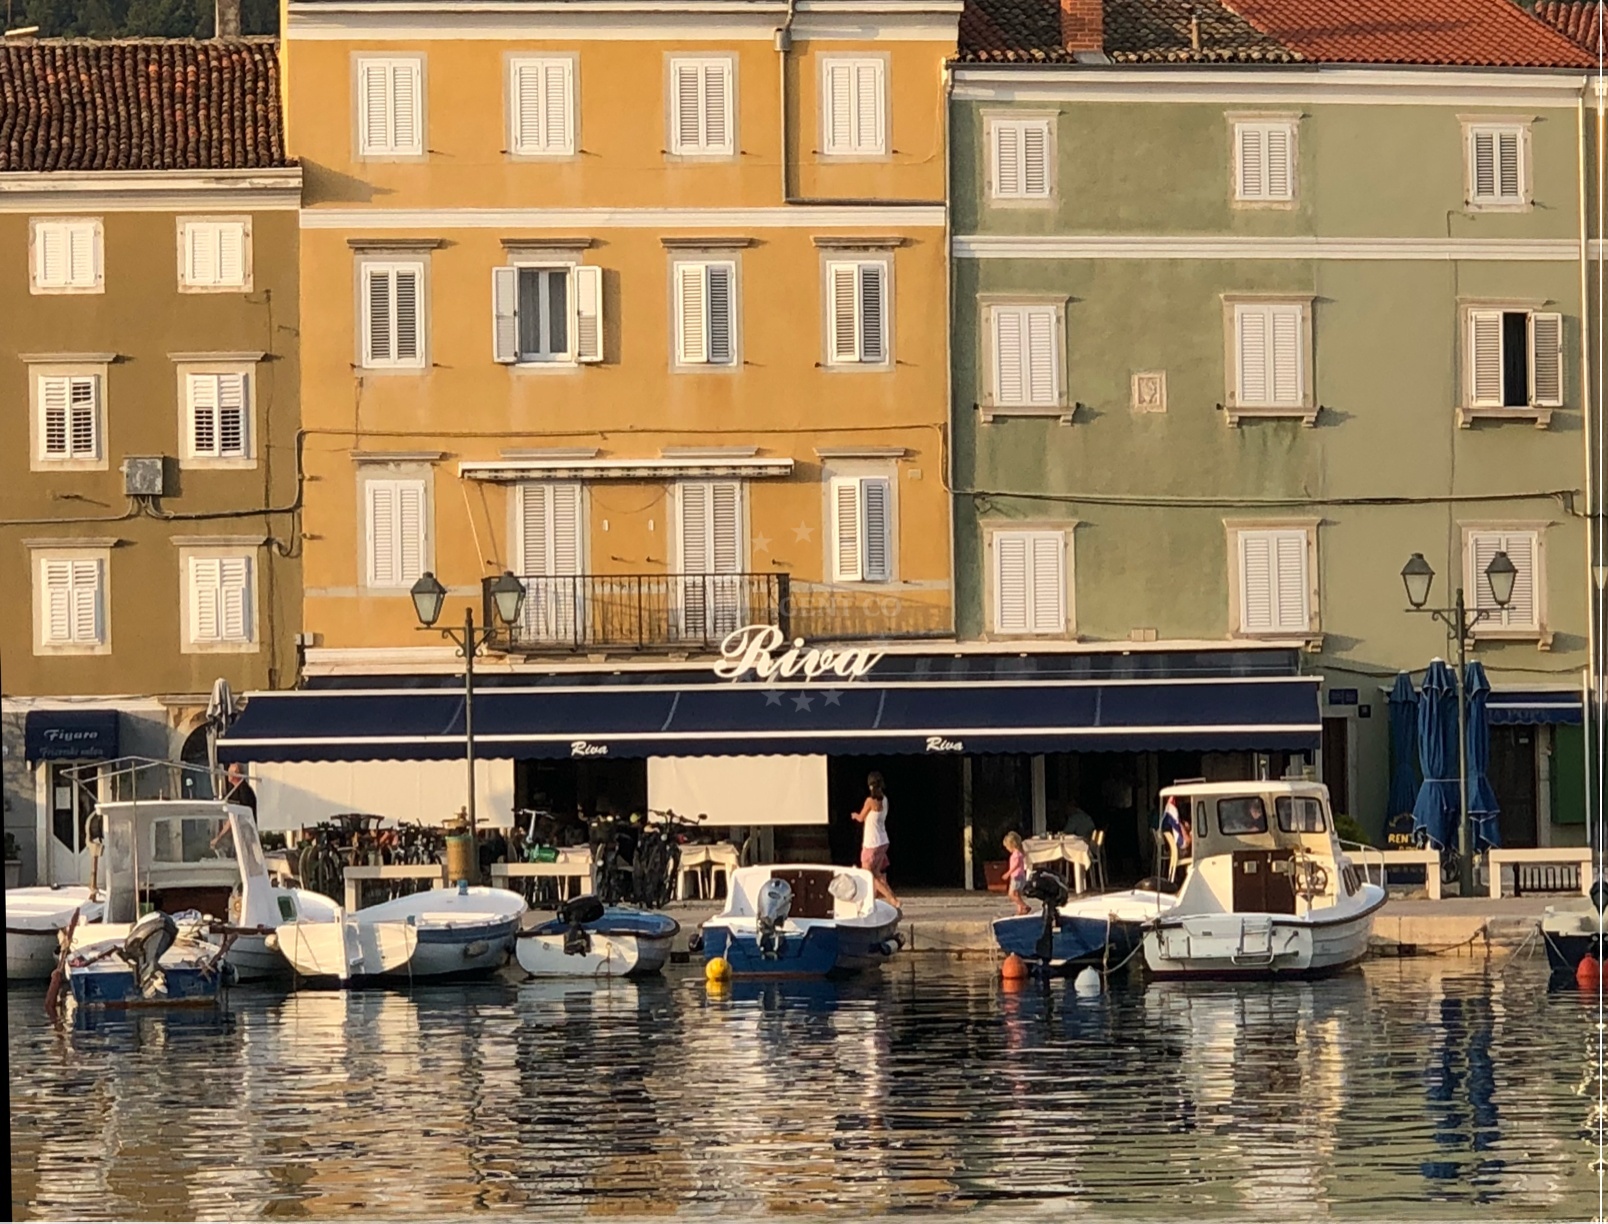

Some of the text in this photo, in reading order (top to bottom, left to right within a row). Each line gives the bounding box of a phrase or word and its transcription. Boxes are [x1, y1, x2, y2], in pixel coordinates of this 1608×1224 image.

[713, 624, 886, 678] Riva
[43, 729, 98, 742] Figaro
[570, 741, 609, 756] Riva
[926, 736, 964, 752] Riva
